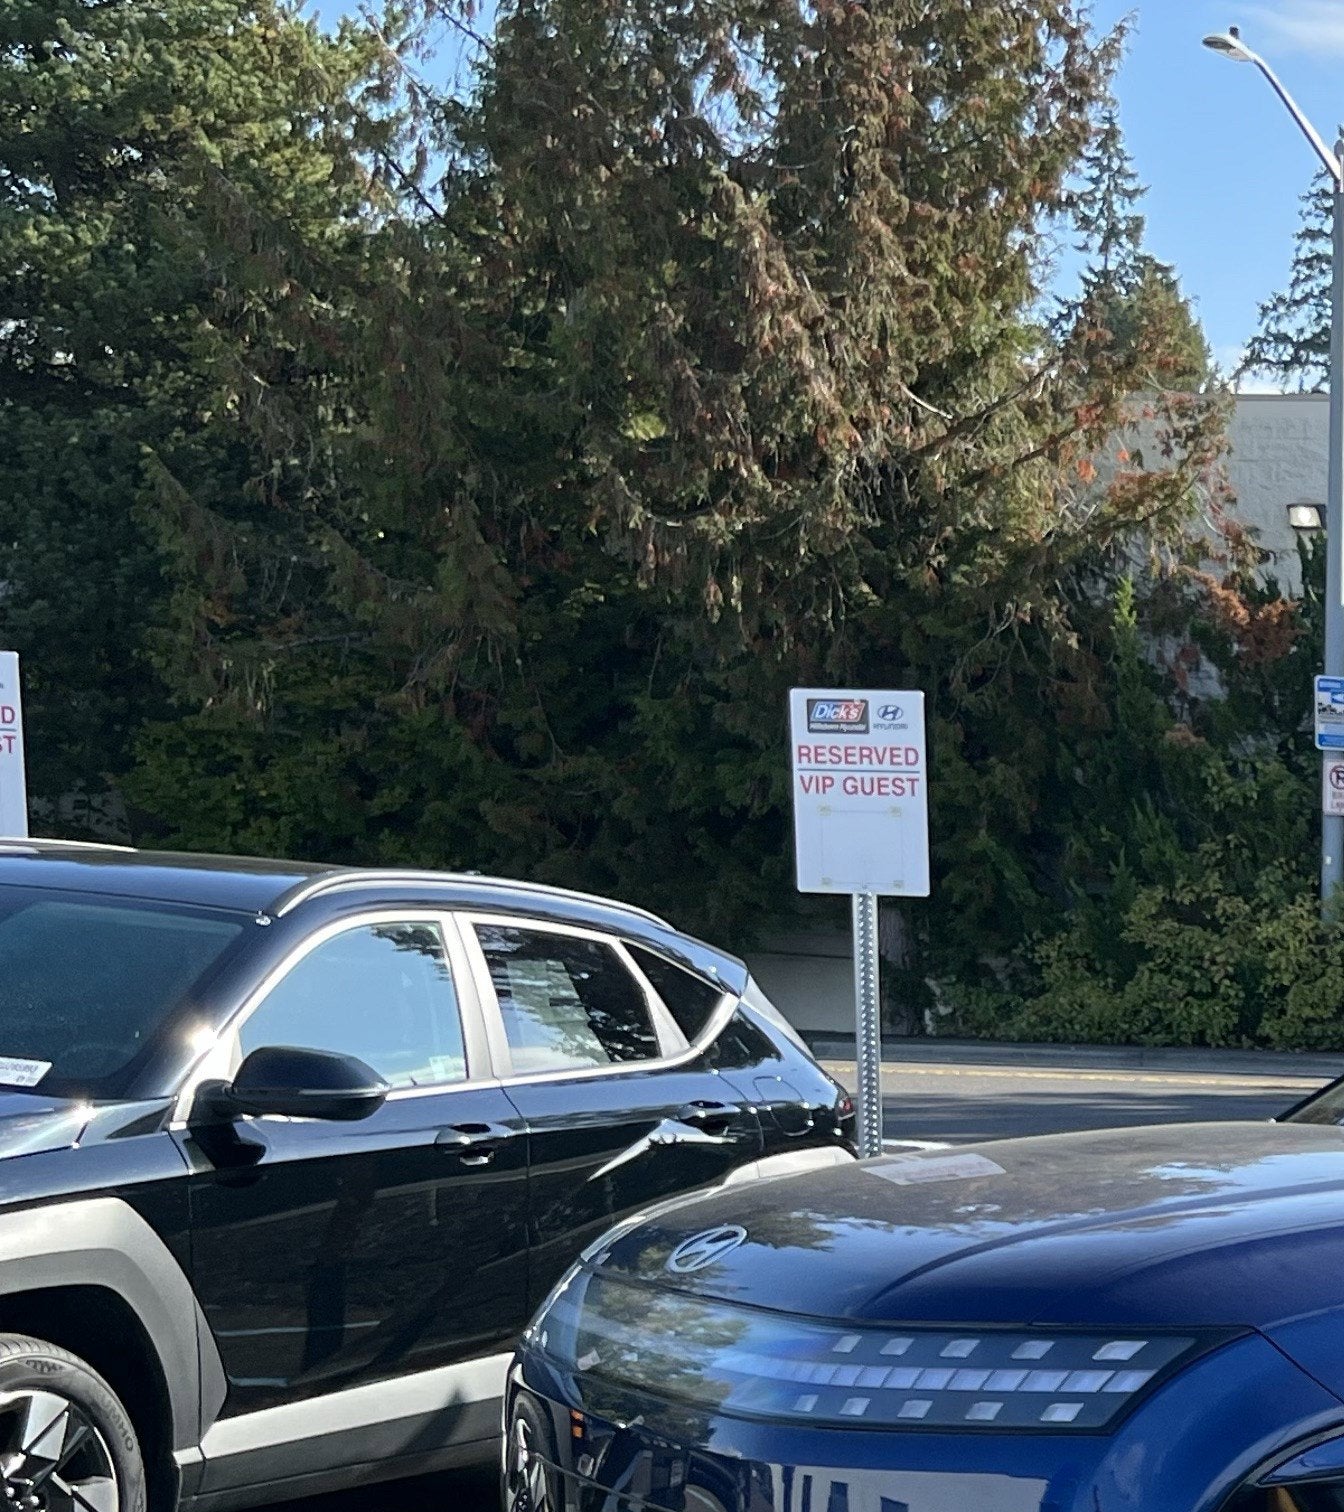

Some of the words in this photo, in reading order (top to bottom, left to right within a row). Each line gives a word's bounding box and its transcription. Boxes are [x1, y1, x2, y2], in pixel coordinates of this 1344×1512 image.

[797, 744, 919, 766] RESERVED
[800, 774, 835, 795] VIP
[842, 776, 920, 797] GUEST
